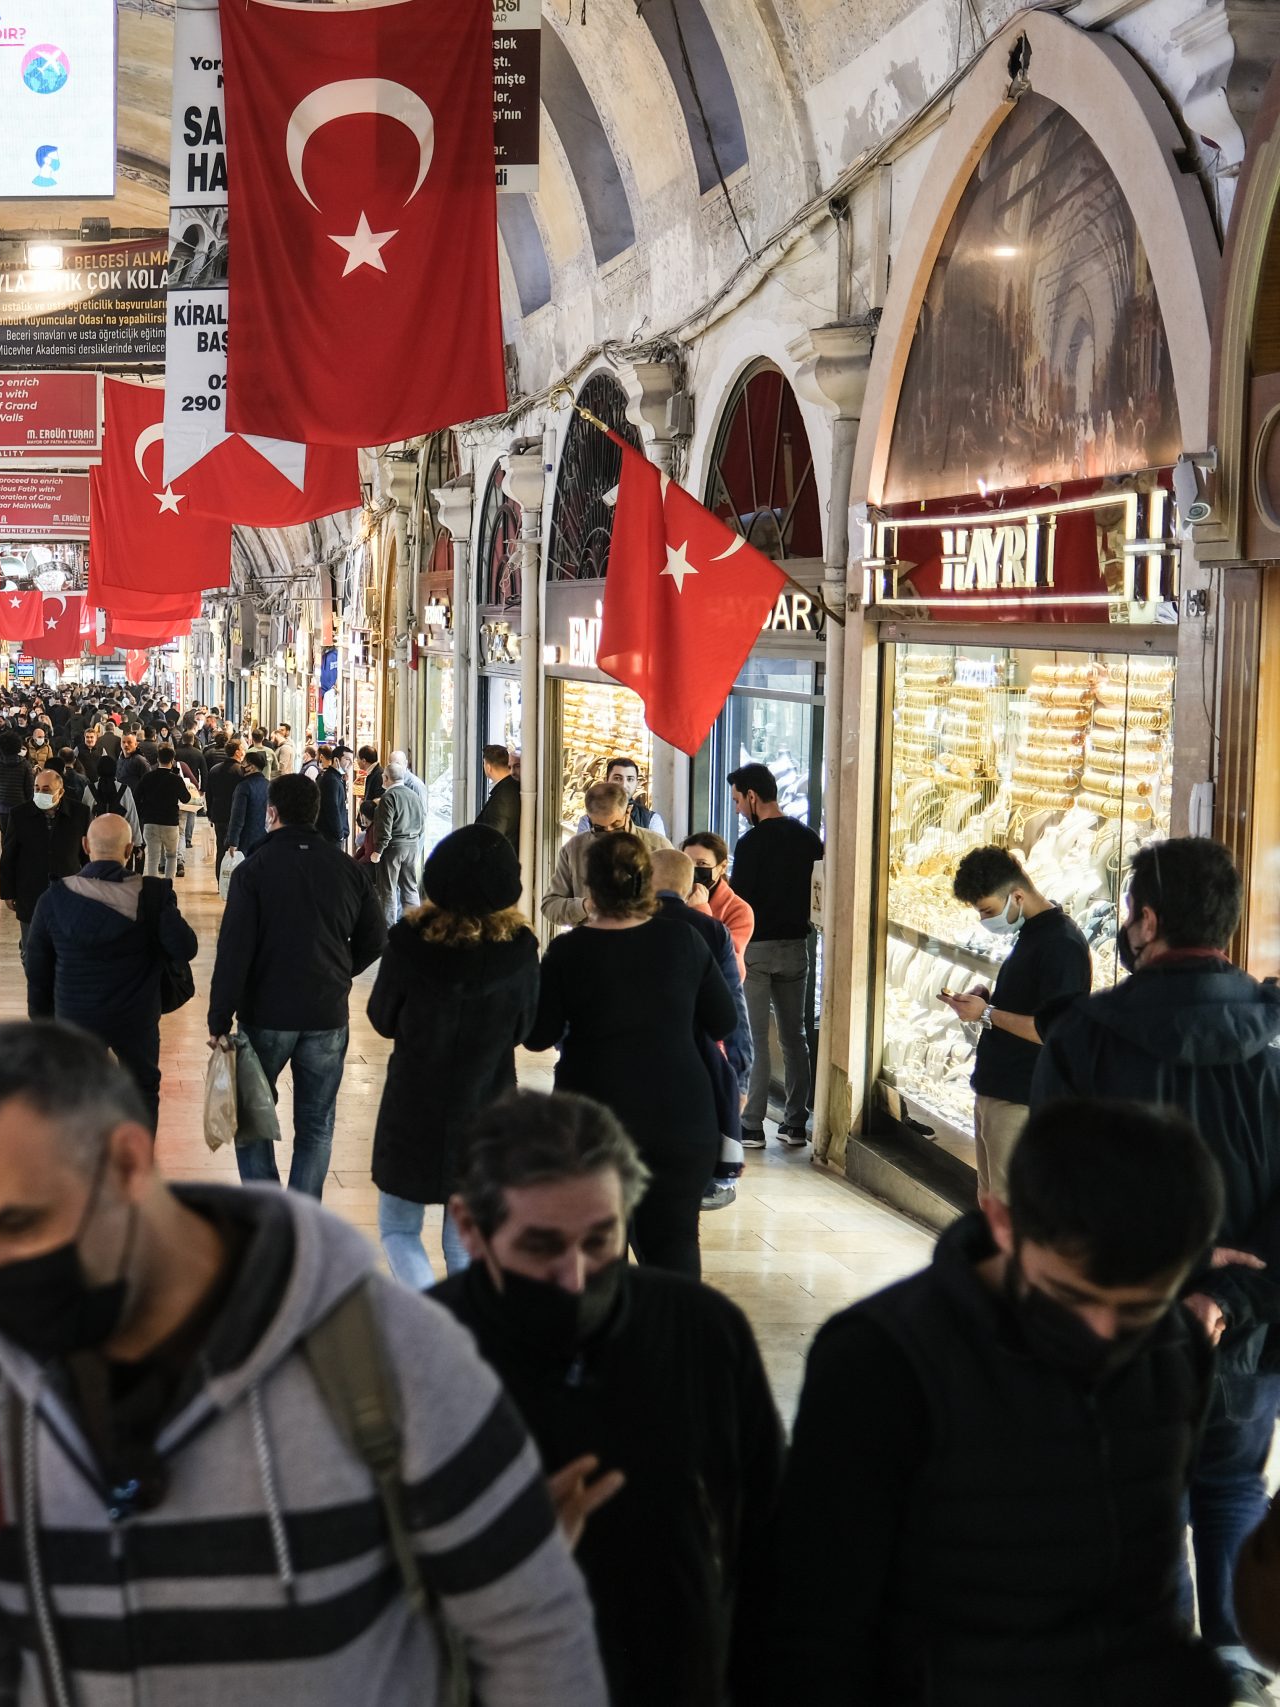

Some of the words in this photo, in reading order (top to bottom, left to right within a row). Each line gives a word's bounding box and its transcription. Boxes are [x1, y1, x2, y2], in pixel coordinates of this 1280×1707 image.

[493, 13, 507, 22] AR
[492, 37, 517, 50] slek
[492, 72, 526, 88] mişte
[184, 106, 226, 146] SA
[187, 152, 228, 192] HA
[75, 250, 129, 270] BELGESİ
[87, 271, 122, 294] ÇOK
[68, 298, 113, 312] öğreticilik
[174, 299, 228, 326] KİRAL
[24, 314, 77, 328] Kuyumcular
[6, 330, 31, 340] Beceri
[32, 329, 66, 340] sınavları
[69, 332, 78, 340] ve
[80, 331, 96, 340] usta
[98, 328, 138, 342] öğreticilik
[140, 328, 166, 341] eğitim
[36, 344, 76, 354] Akademisi
[78, 342, 132, 354] dersliklerinde
[134, 342, 166, 353] verilece
[6, 378, 39, 387] enrich
[5, 390, 28, 398] with
[5, 402, 37, 410] Grand
[182, 395, 221, 412] 290
[27, 430, 38, 439] M.
[40, 428, 67, 439] ERGÜN
[68, 429, 94, 438] TURAN
[38, 494, 62, 502] Grand
